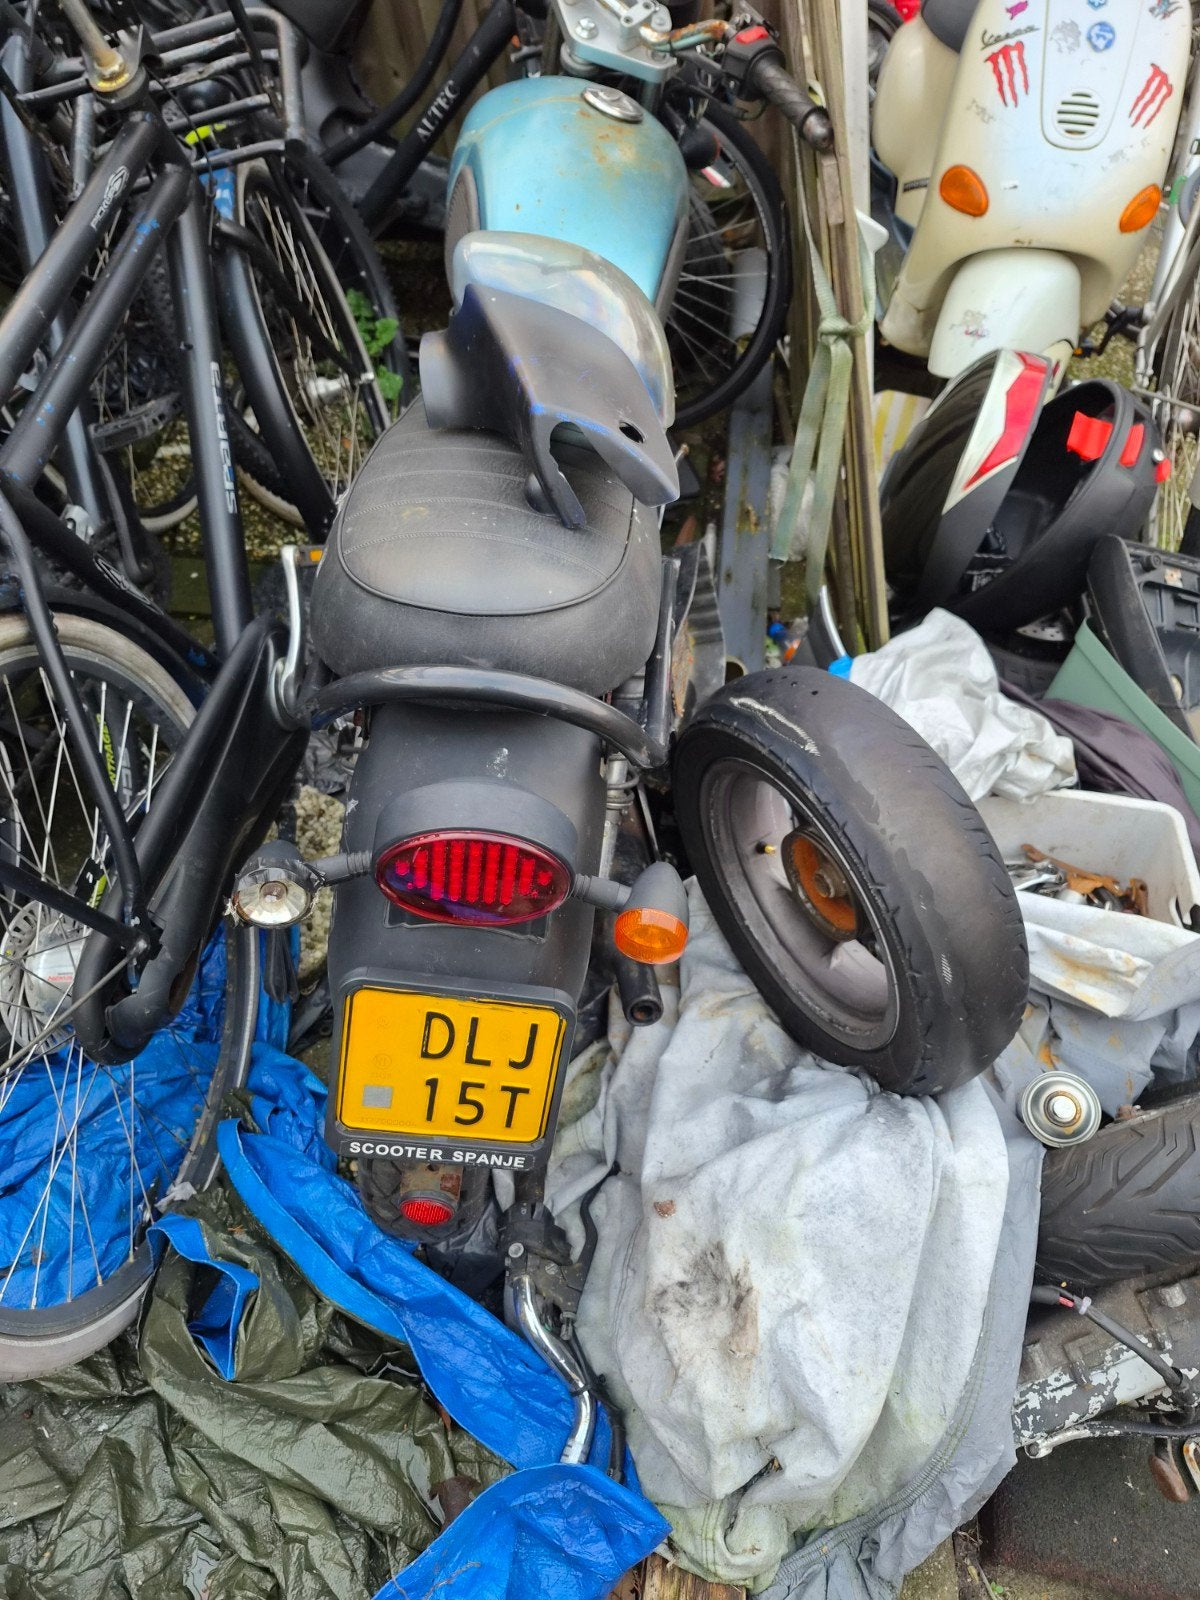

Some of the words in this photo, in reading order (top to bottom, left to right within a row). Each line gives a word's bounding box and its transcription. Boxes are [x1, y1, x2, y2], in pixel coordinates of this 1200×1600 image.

[416, 79, 459, 142] ALTEC
[420, 1010, 540, 1070] DLJ
[424, 1077, 531, 1129] 15T
[349, 1141, 444, 1162] SCOOTER
[452, 1150, 526, 1169] SPANJE
